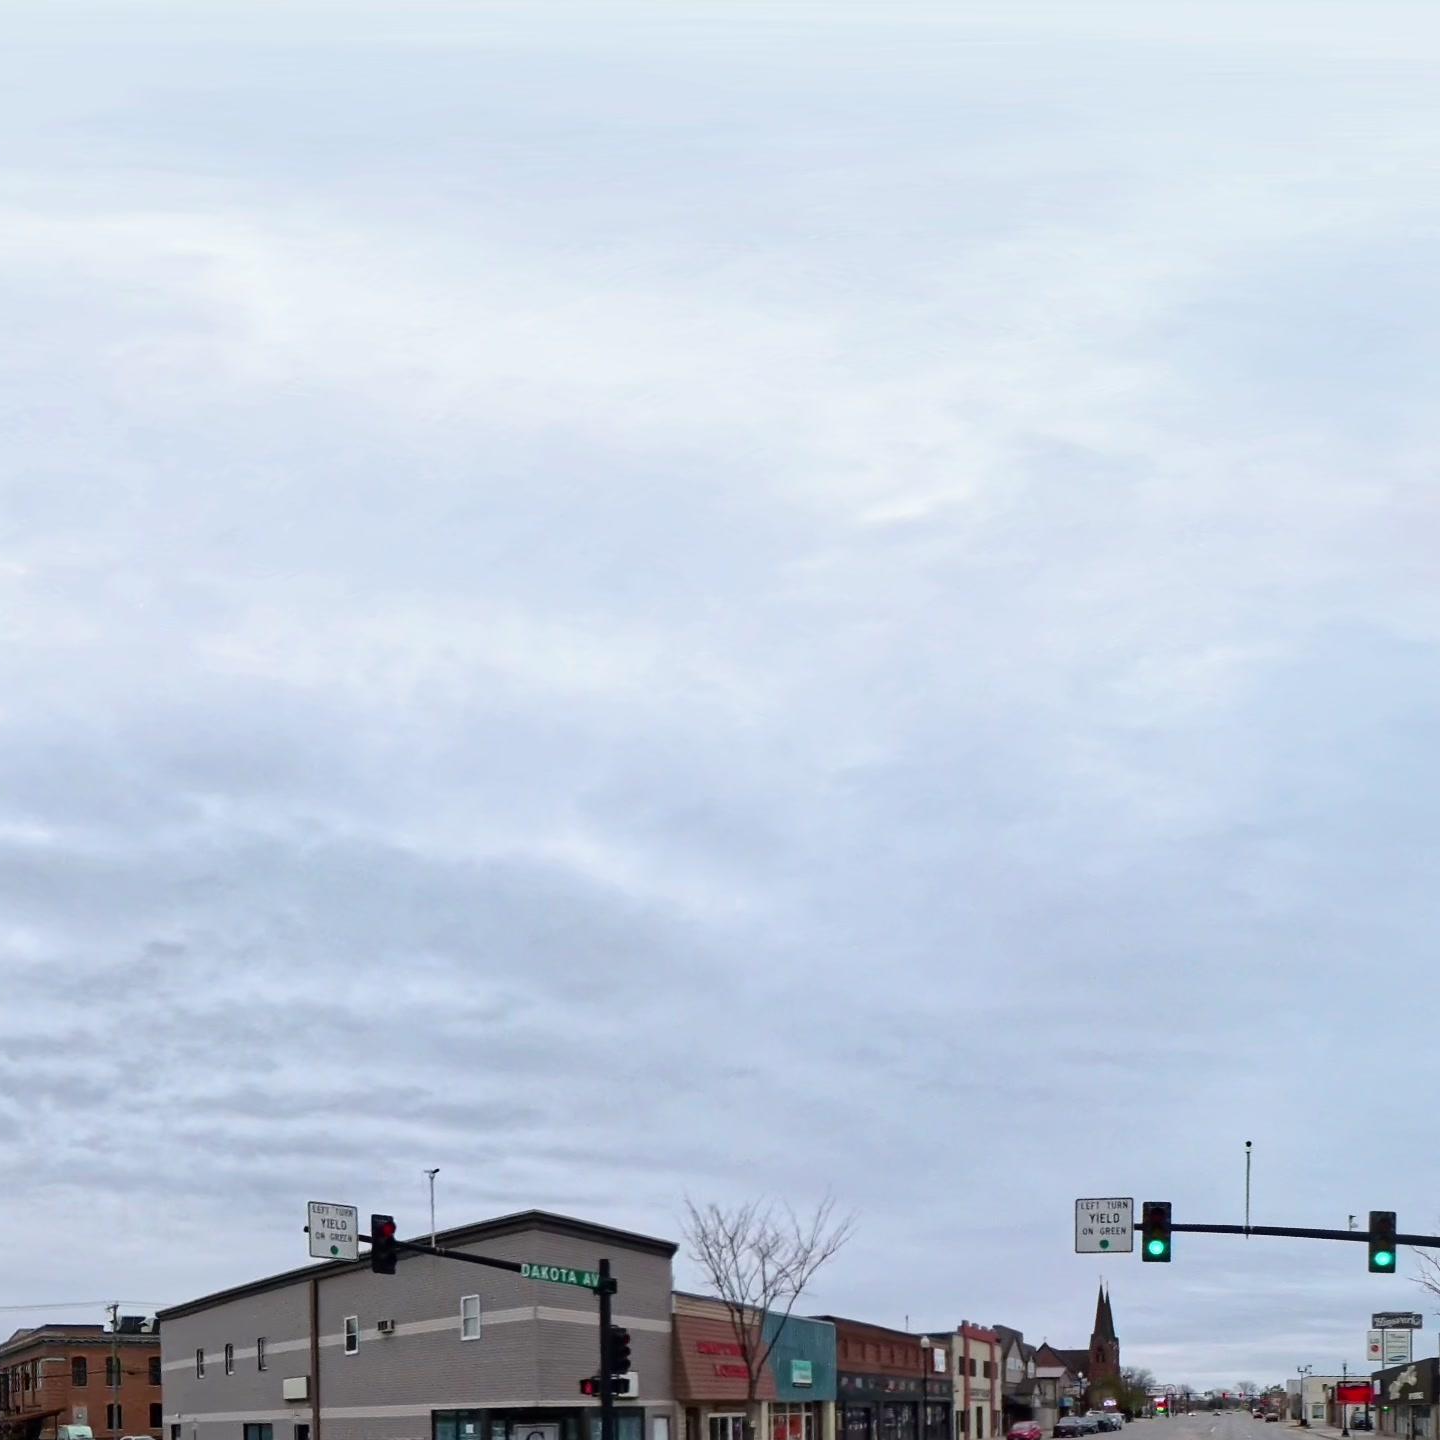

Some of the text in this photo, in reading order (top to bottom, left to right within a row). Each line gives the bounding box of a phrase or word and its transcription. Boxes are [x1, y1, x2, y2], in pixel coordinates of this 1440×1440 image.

[312, 1204, 353, 1217] LEFT TURN
[1080, 1200, 1128, 1210] LEFT TURN
[321, 1218, 347, 1230] YIELD
[1089, 1213, 1120, 1224] YIELD
[315, 1231, 352, 1242] ON GREEN
[1082, 1226, 1126, 1236] ON GREEN
[521, 1263, 599, 1287] DAKOTA AV
